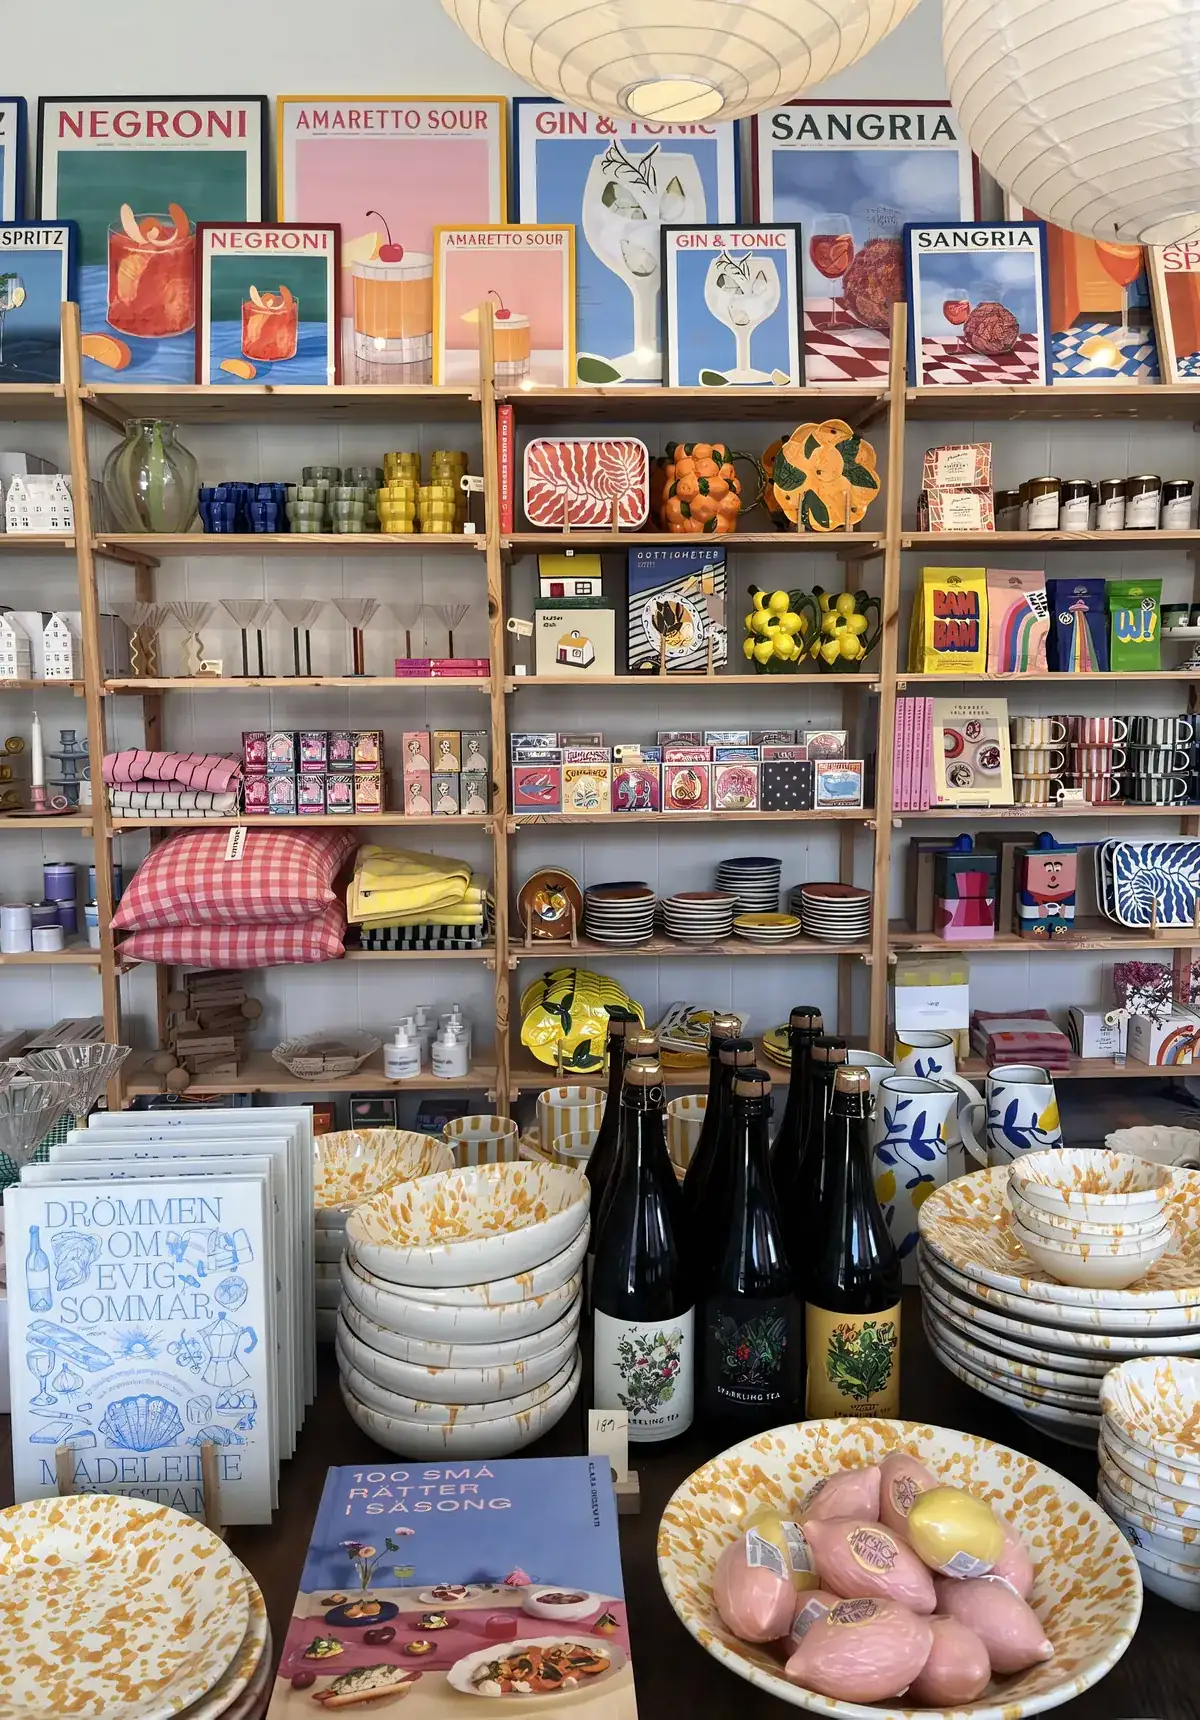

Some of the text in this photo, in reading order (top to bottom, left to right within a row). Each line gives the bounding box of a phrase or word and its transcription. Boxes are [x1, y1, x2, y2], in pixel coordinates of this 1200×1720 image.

[58, 110, 247, 138] NEGRONI
[296, 110, 488, 129] AMARETTO SOUR
[535, 111, 587, 134] GIN
[771, 113, 957, 140] SANGRIA
[2, 230, 63, 245] SPRITZ
[210, 232, 327, 249] NEGRONI
[446, 234, 563, 245] AMARETTO SOUR
[676, 234, 787, 247] GIN & TONIC
[918, 231, 1033, 247] SANGRIA
[933, 590, 980, 619] BAM
[933, 620, 980, 652] BAM
[45, 1196, 222, 1228] DRÖMMEN
[108, 1231, 163, 1258] OM
[96, 1262, 176, 1290] EVIG
[60, 1294, 214, 1324] SOMMAR
[766, 1392, 780, 1400] TEA
[39, 1455, 242, 1485] MADELEIE
[353, 1465, 495, 1483] 100 SMÅ
[349, 1485, 479, 1499] RÄTTER
[345, 1498, 512, 1515] I SÄSONG
